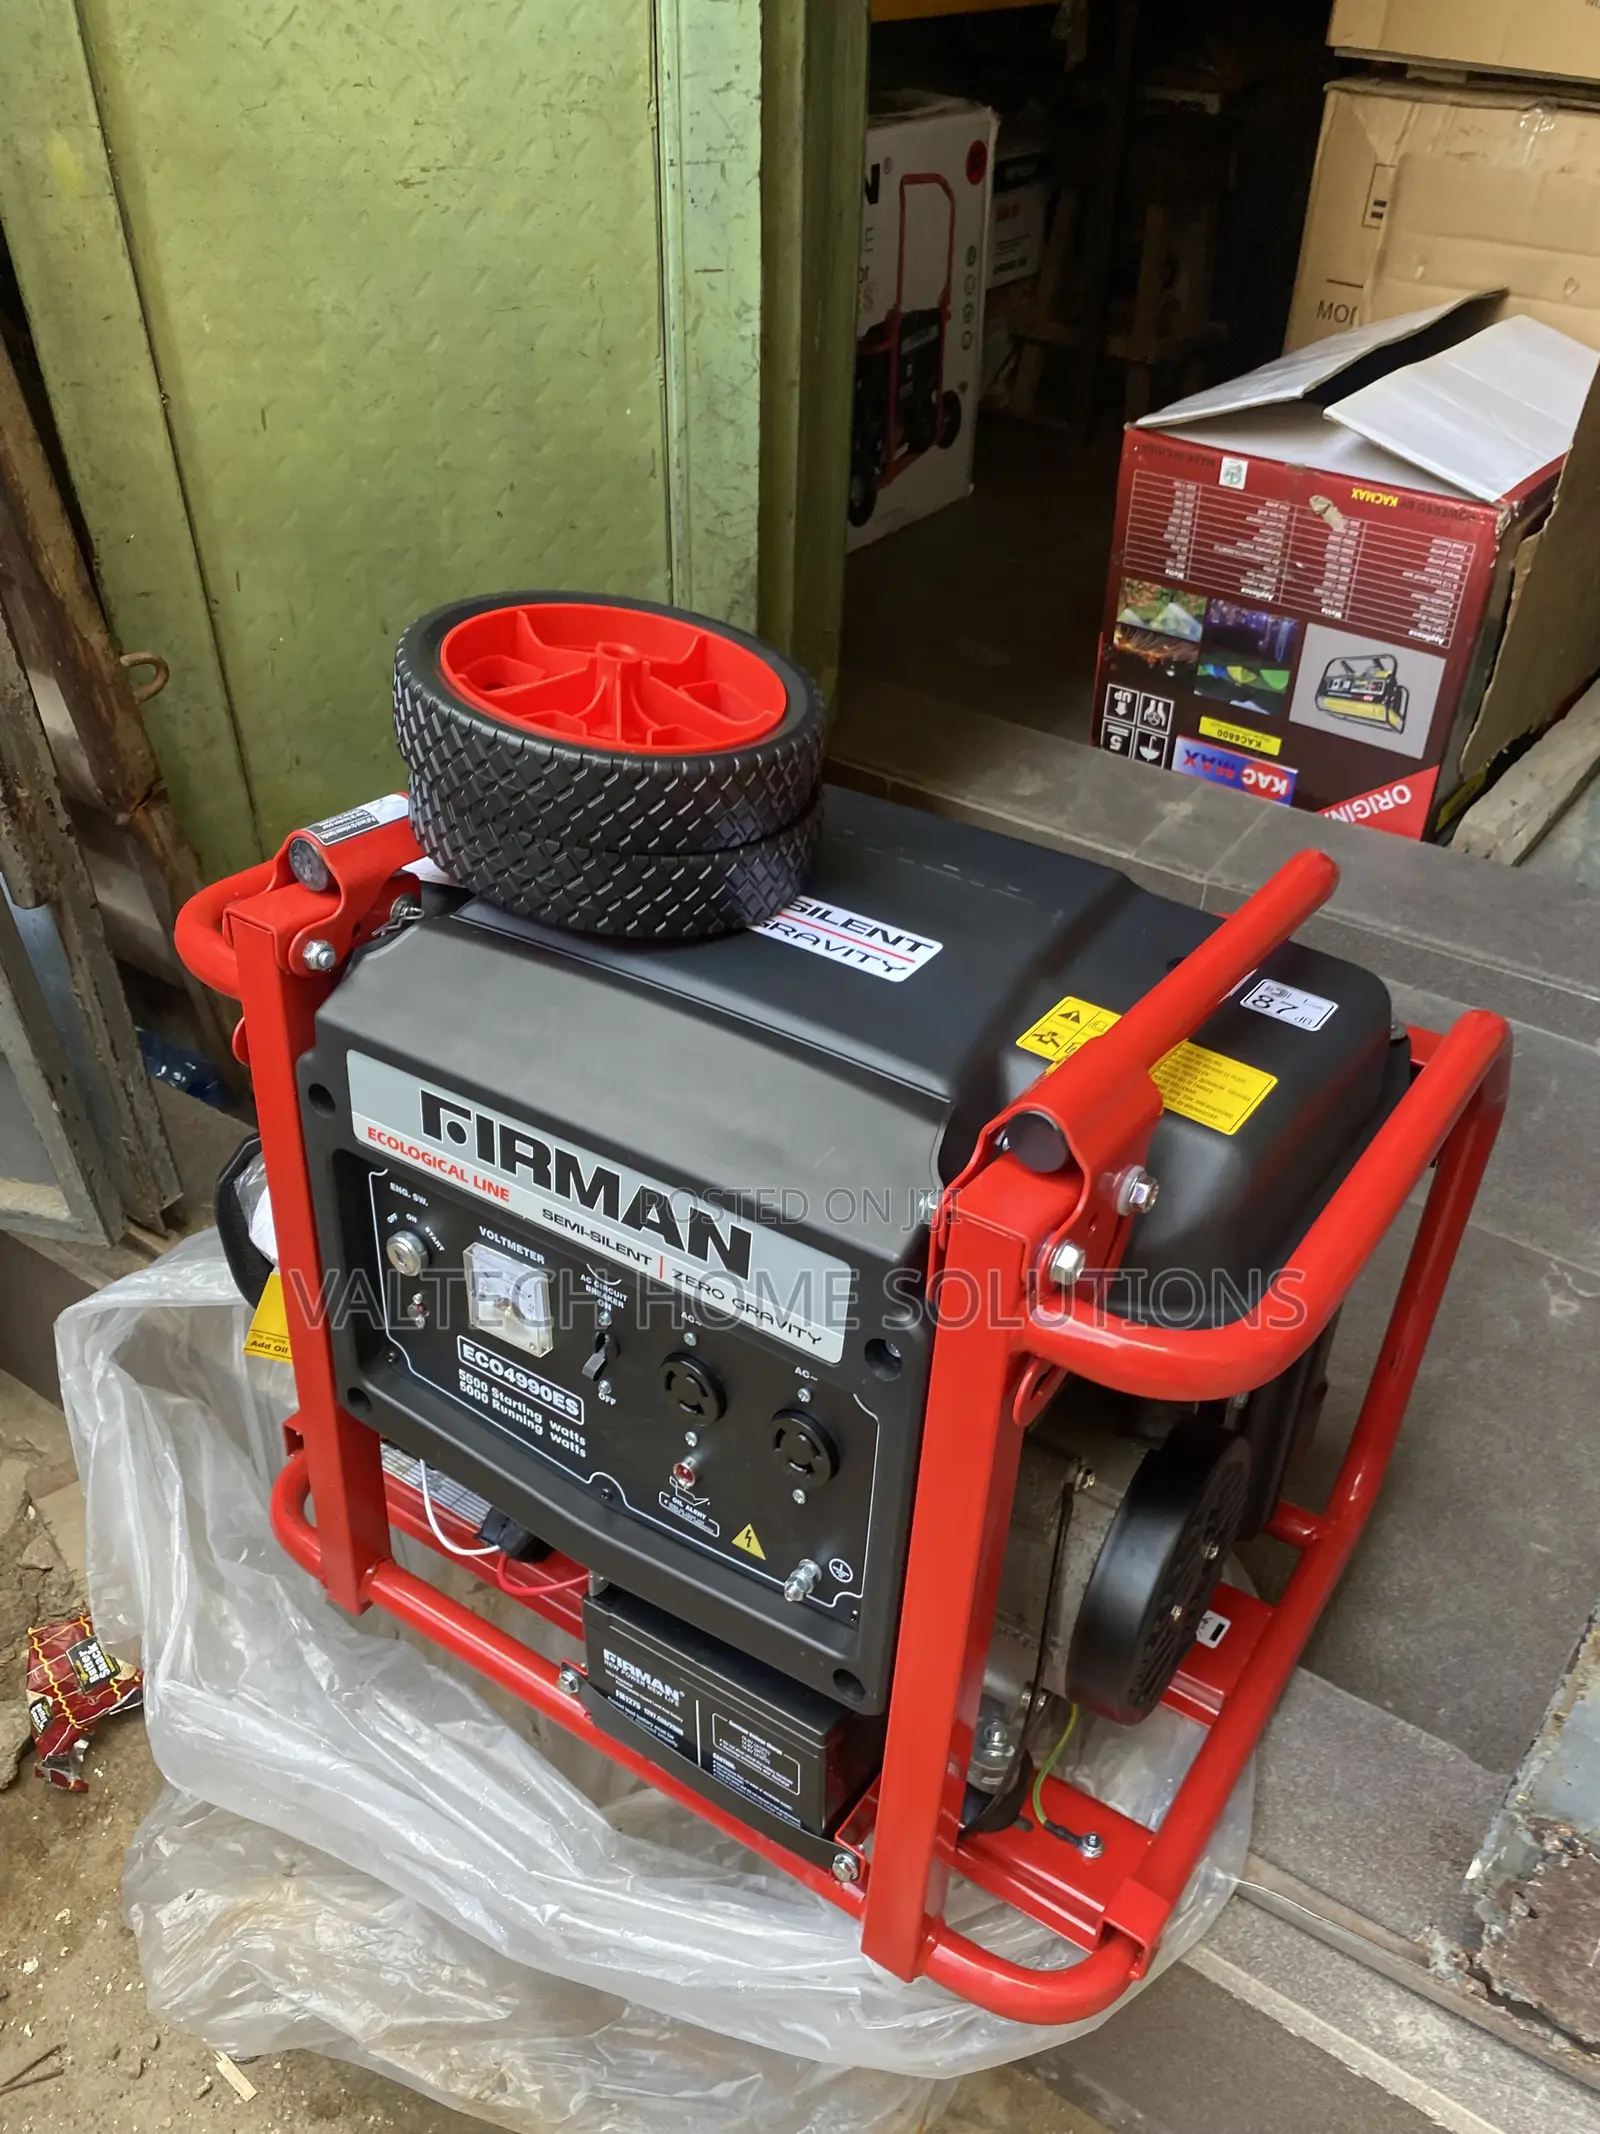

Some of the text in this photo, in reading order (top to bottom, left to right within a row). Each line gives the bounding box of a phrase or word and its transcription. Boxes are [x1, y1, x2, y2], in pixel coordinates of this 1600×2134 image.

[1350, 486, 1400, 509] KACMAX
[1113, 689, 1133, 704] UP
[1107, 734, 1123, 751] 5
[1180, 749, 1289, 796] KAC MAX
[1322, 782, 1413, 824] ORIGIN
[1252, 995, 1299, 1015] 87
[367, 1125, 511, 1203] ECOLOGICAL LINE
[390, 1182, 429, 1206] ENG. SW.
[419, 1087, 753, 1282] FIRMAN
[387, 1212, 398, 1224] OFF
[405, 1213, 418, 1224] ON
[424, 1226, 445, 1252] START
[478, 1225, 545, 1265] VOLTMETER
[542, 1208, 823, 1346] SEMI-SILENT ZERO GRAVITY
[580, 1274, 628, 1303] AC CIRCUIT
[585, 1284, 625, 1310] BREAKER
[597, 1299, 612, 1312] ON
[250, 1340, 288, 1354] Add Oil
[462, 1342, 579, 1417] ECO4990ES
[458, 1368, 586, 1447] 5500 Starting watts
[598, 1392, 617, 1406] OFF
[459, 1380, 587, 1458] 5000 Running watts
[671, 1497, 683, 1508] OIL
[686, 1503, 707, 1521] ALERT
[78, 1650, 100, 1684] Butter
[87, 1641, 111, 1679] Snack
